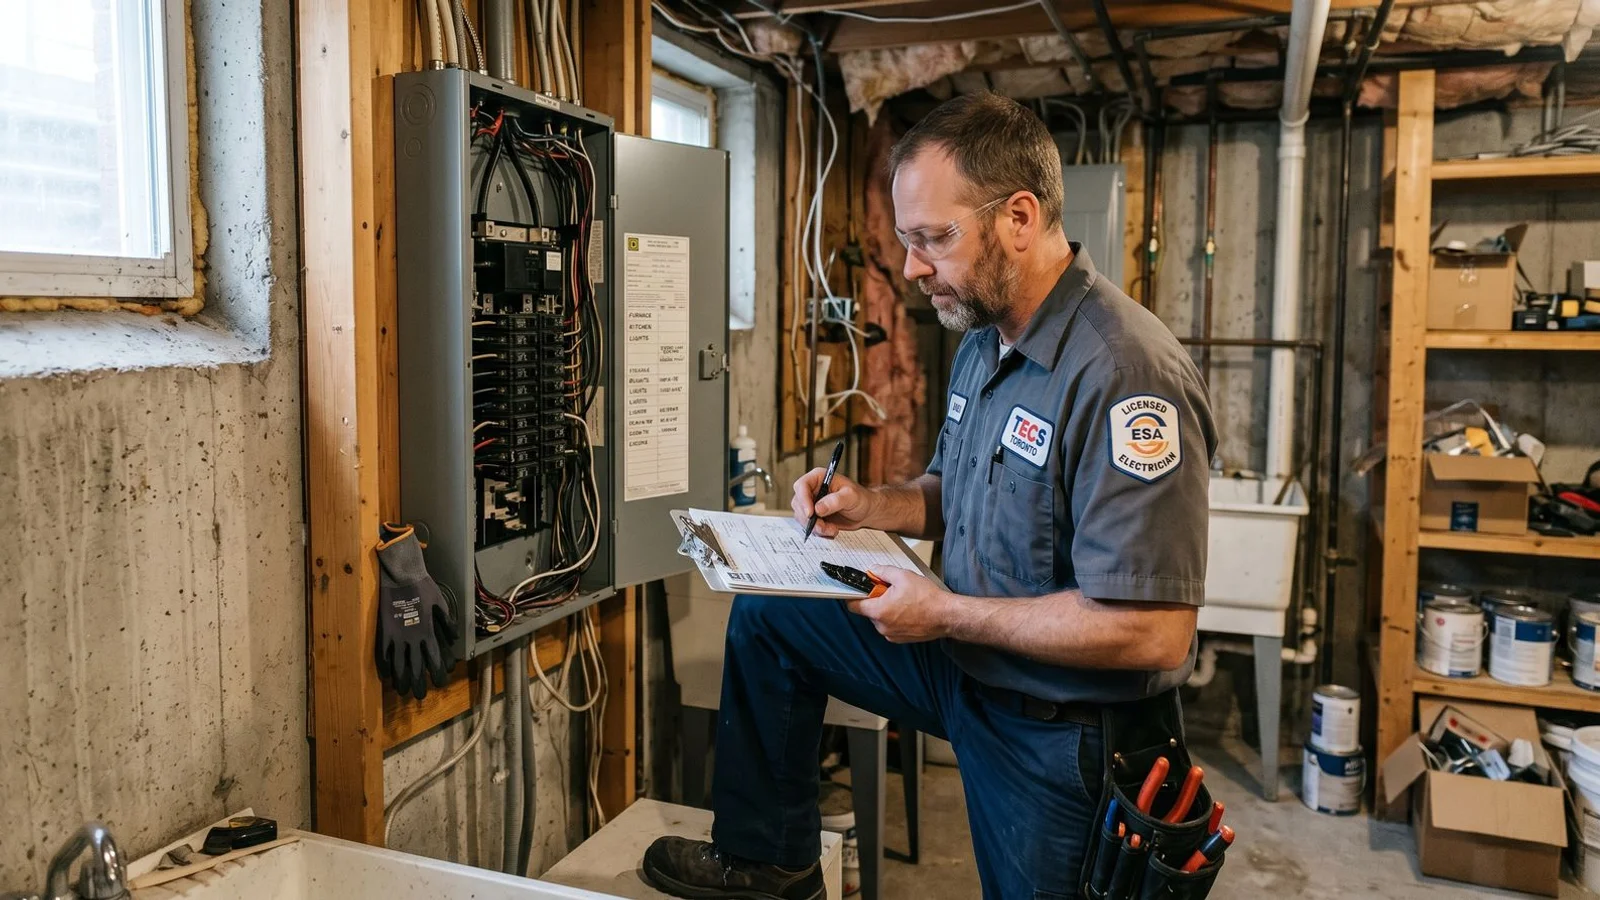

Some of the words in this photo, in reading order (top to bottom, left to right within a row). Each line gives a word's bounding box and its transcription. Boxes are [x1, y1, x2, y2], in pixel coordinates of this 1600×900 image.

[1121, 400, 1168, 415] LICENSED
[1012, 415, 1047, 447] TECS
[1131, 428, 1164, 441] ESA
[1010, 434, 1038, 456] TORONTO
[1118, 451, 1177, 472] ELECTRICIAN
